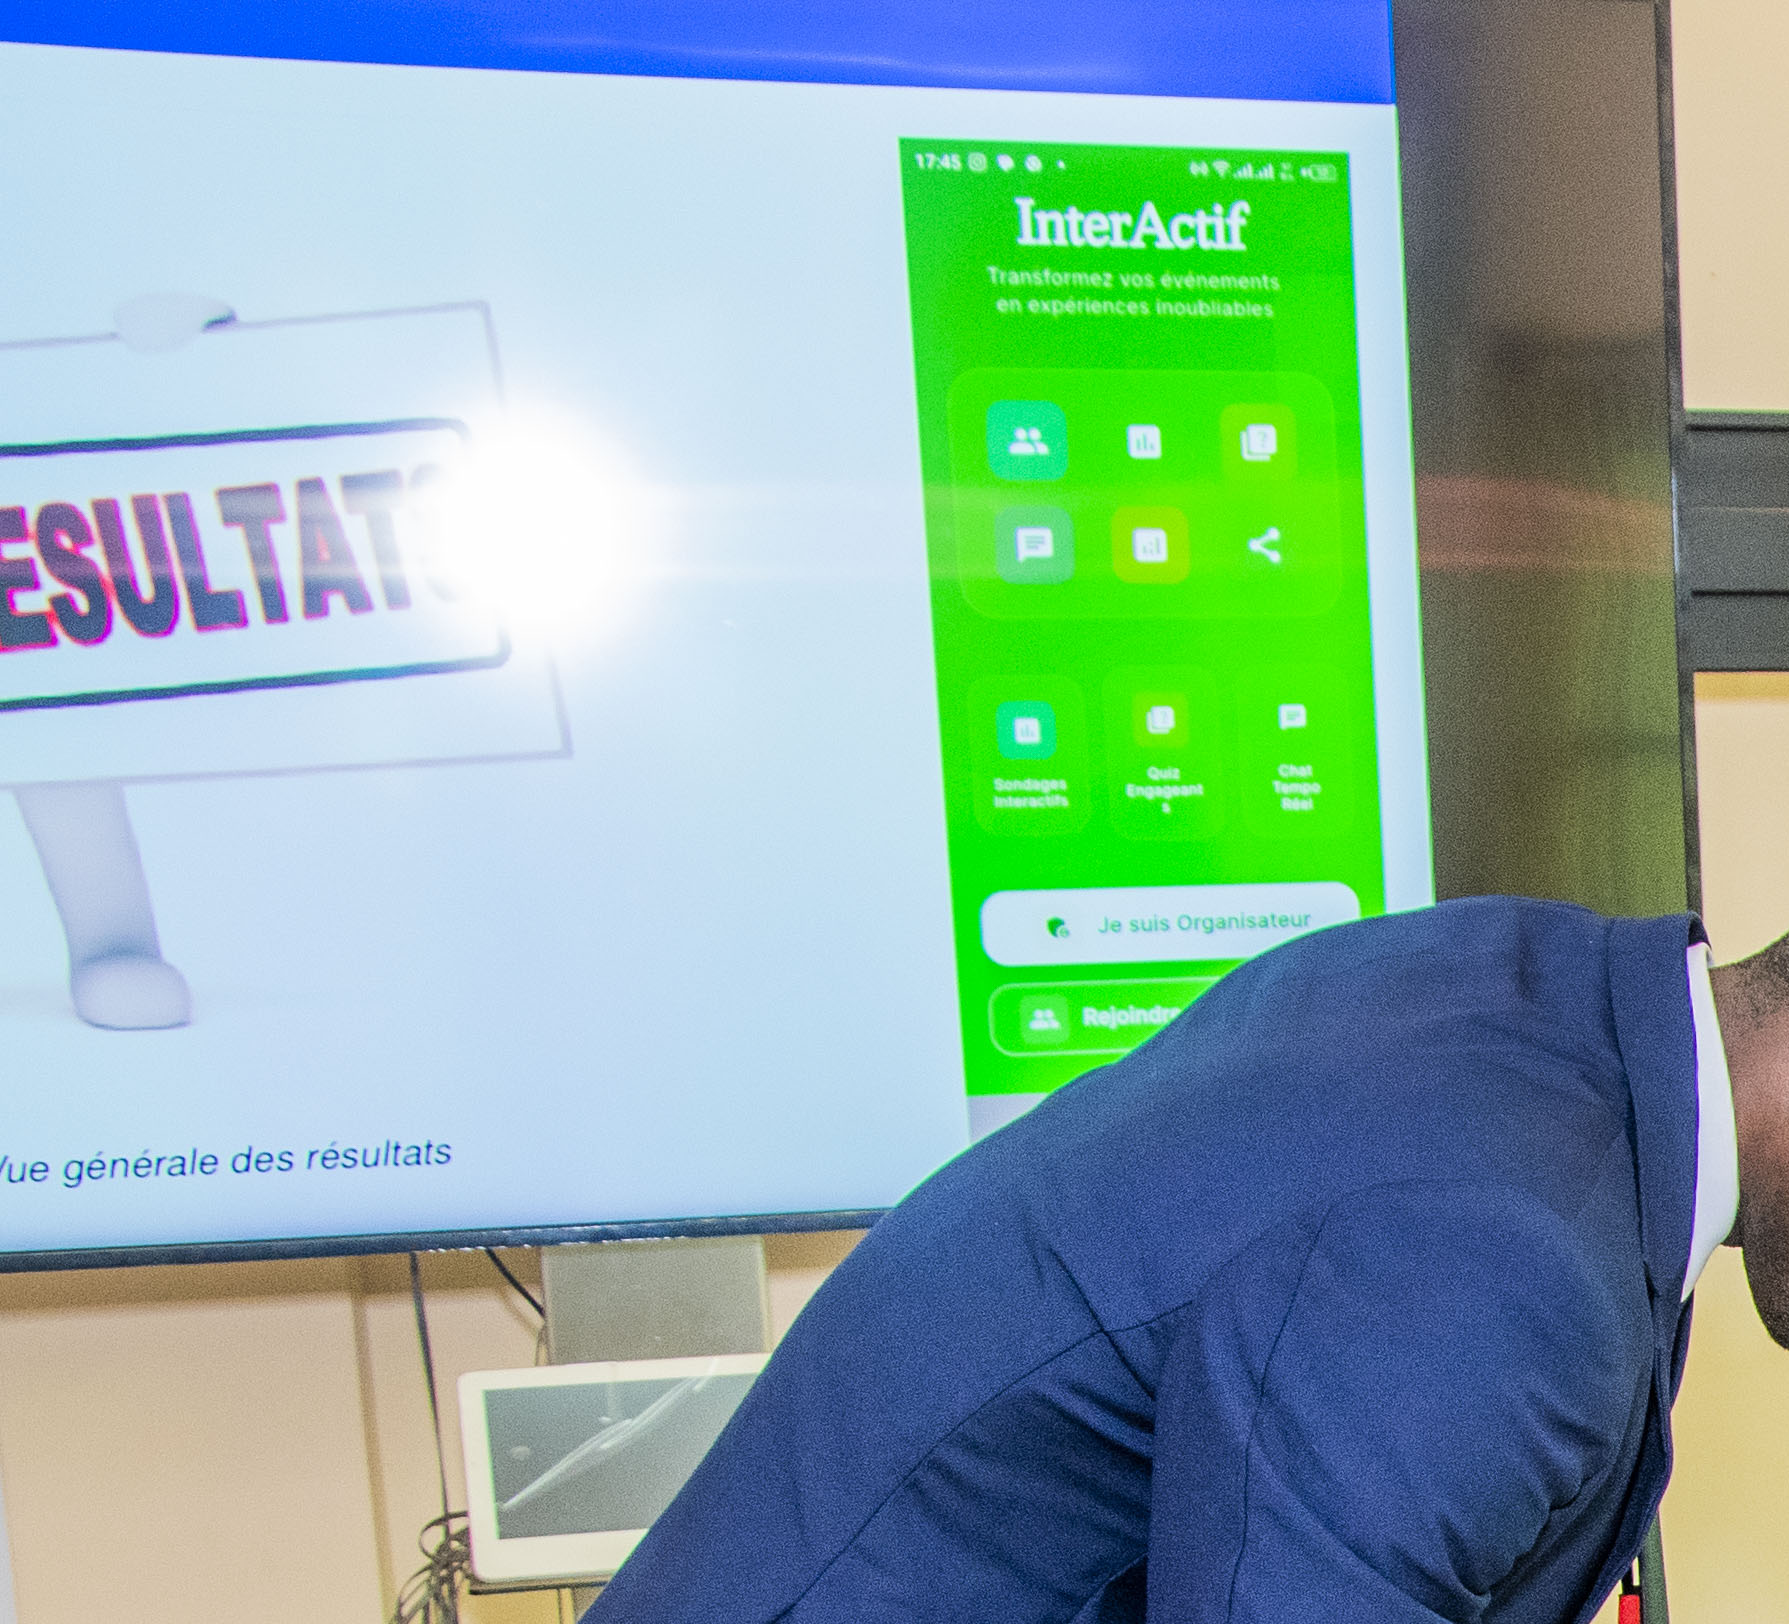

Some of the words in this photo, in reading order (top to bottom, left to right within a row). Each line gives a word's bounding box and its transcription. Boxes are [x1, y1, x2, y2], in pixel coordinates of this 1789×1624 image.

[915, 152, 961, 172] 17:45
[1014, 196, 1251, 251] InterActif
[987, 266, 1113, 289] Transformez
[1120, 273, 1155, 289] vos
[1160, 270, 1281, 293] événements
[997, 298, 1022, 314] en
[1028, 297, 1150, 321] expériences
[1156, 299, 1274, 319] inoubliables
[1147, 766, 1181, 781] Quiz
[1278, 764, 1313, 778] Chat
[994, 777, 1067, 794] Sondages
[1098, 916, 1122, 933] Je
[1129, 914, 1170, 932] suis
[1177, 912, 1311, 933] Organisateur
[62, 1147, 219, 1189] générale
[230, 1145, 294, 1175] des
[306, 1139, 452, 1171] résultats
